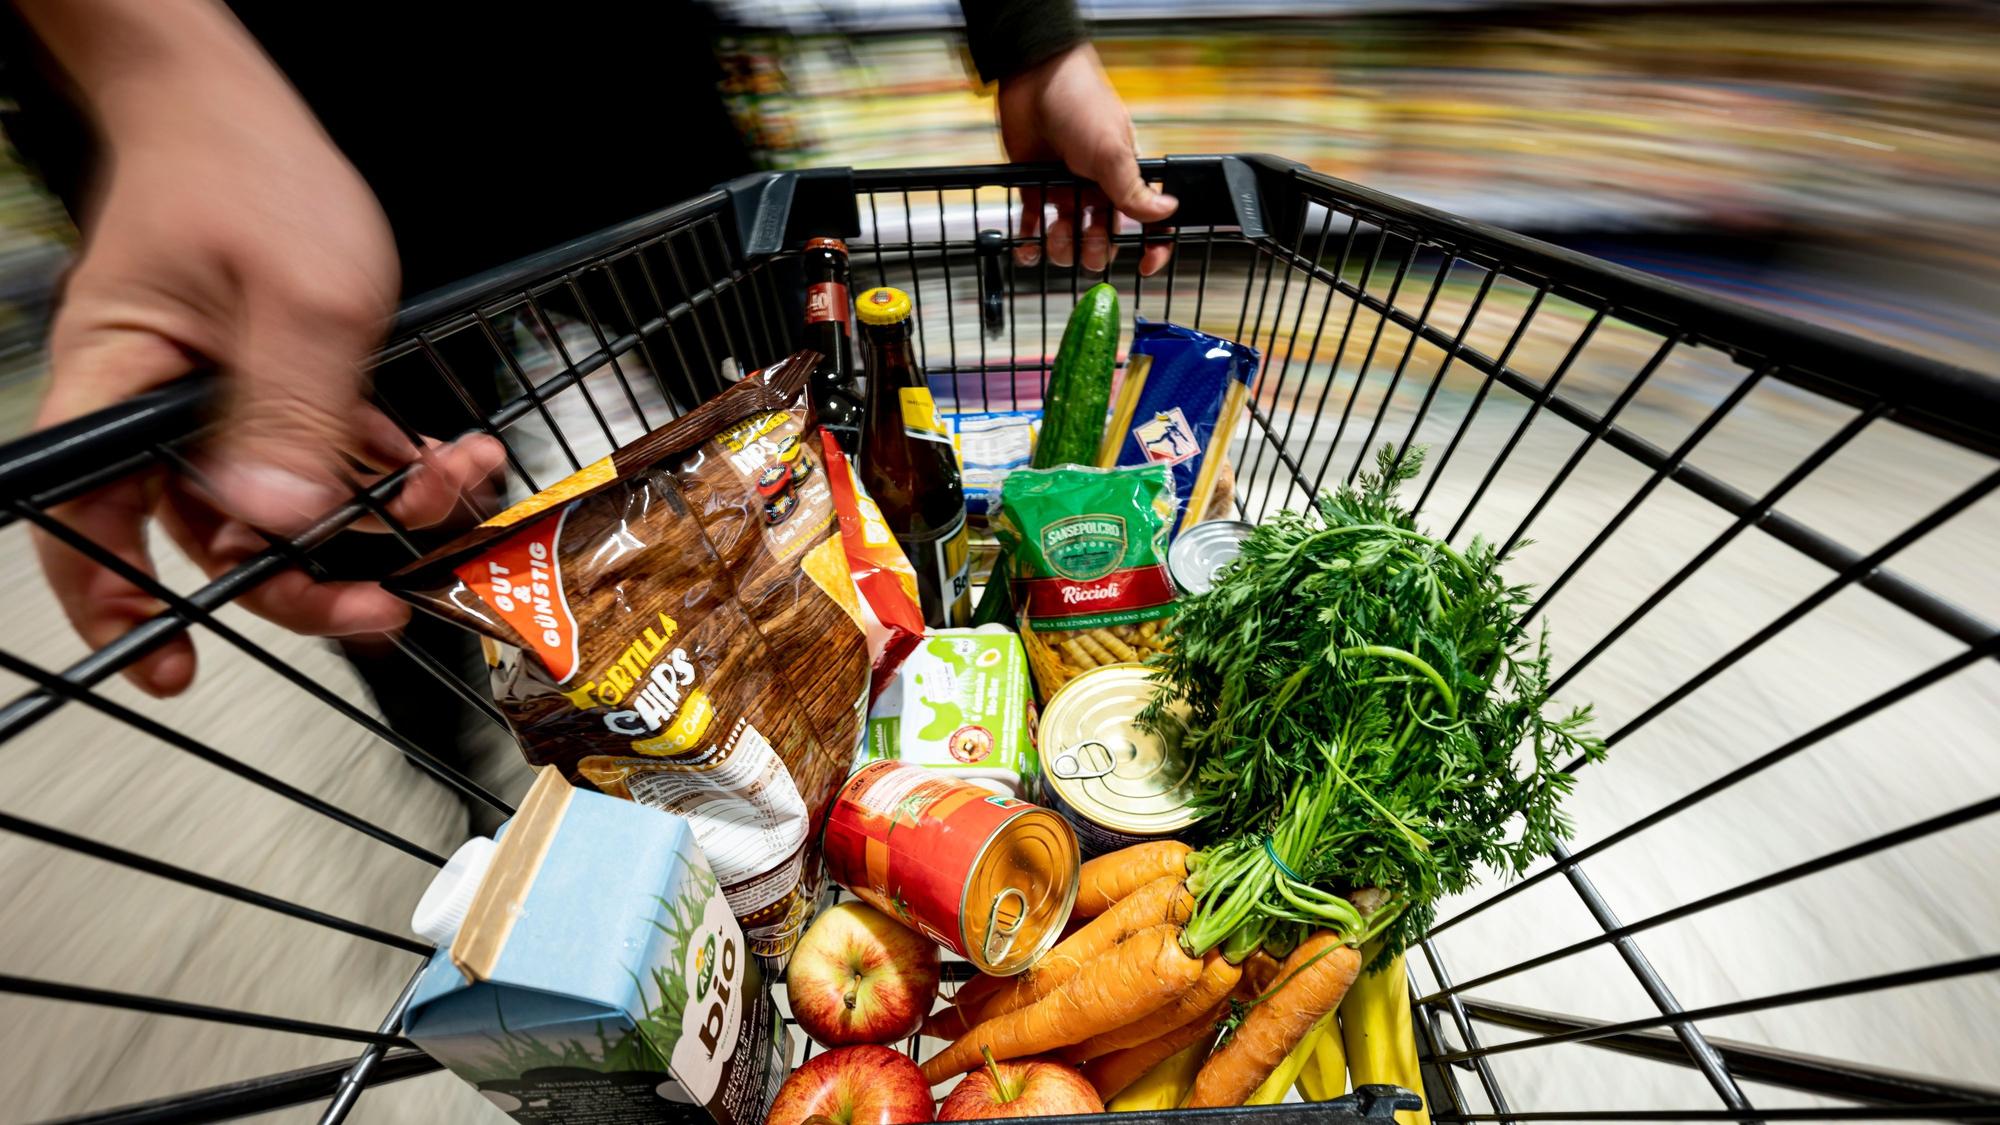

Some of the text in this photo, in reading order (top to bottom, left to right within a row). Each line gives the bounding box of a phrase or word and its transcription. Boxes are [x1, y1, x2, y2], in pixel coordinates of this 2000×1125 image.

[1048, 521, 1120, 546] SANSEPOLCRO
[1057, 541, 1113, 556] FACTORY
[489, 561, 515, 612] GUT
[513, 585, 532, 604] &
[529, 542, 561, 648] GÜNSTIG
[1062, 582, 1120, 605] Riccioli
[562, 610, 679, 710] TORTILLA
[603, 647, 696, 736] CHIPS
[699, 945, 715, 995] Arla
[699, 937, 736, 1061] bio
